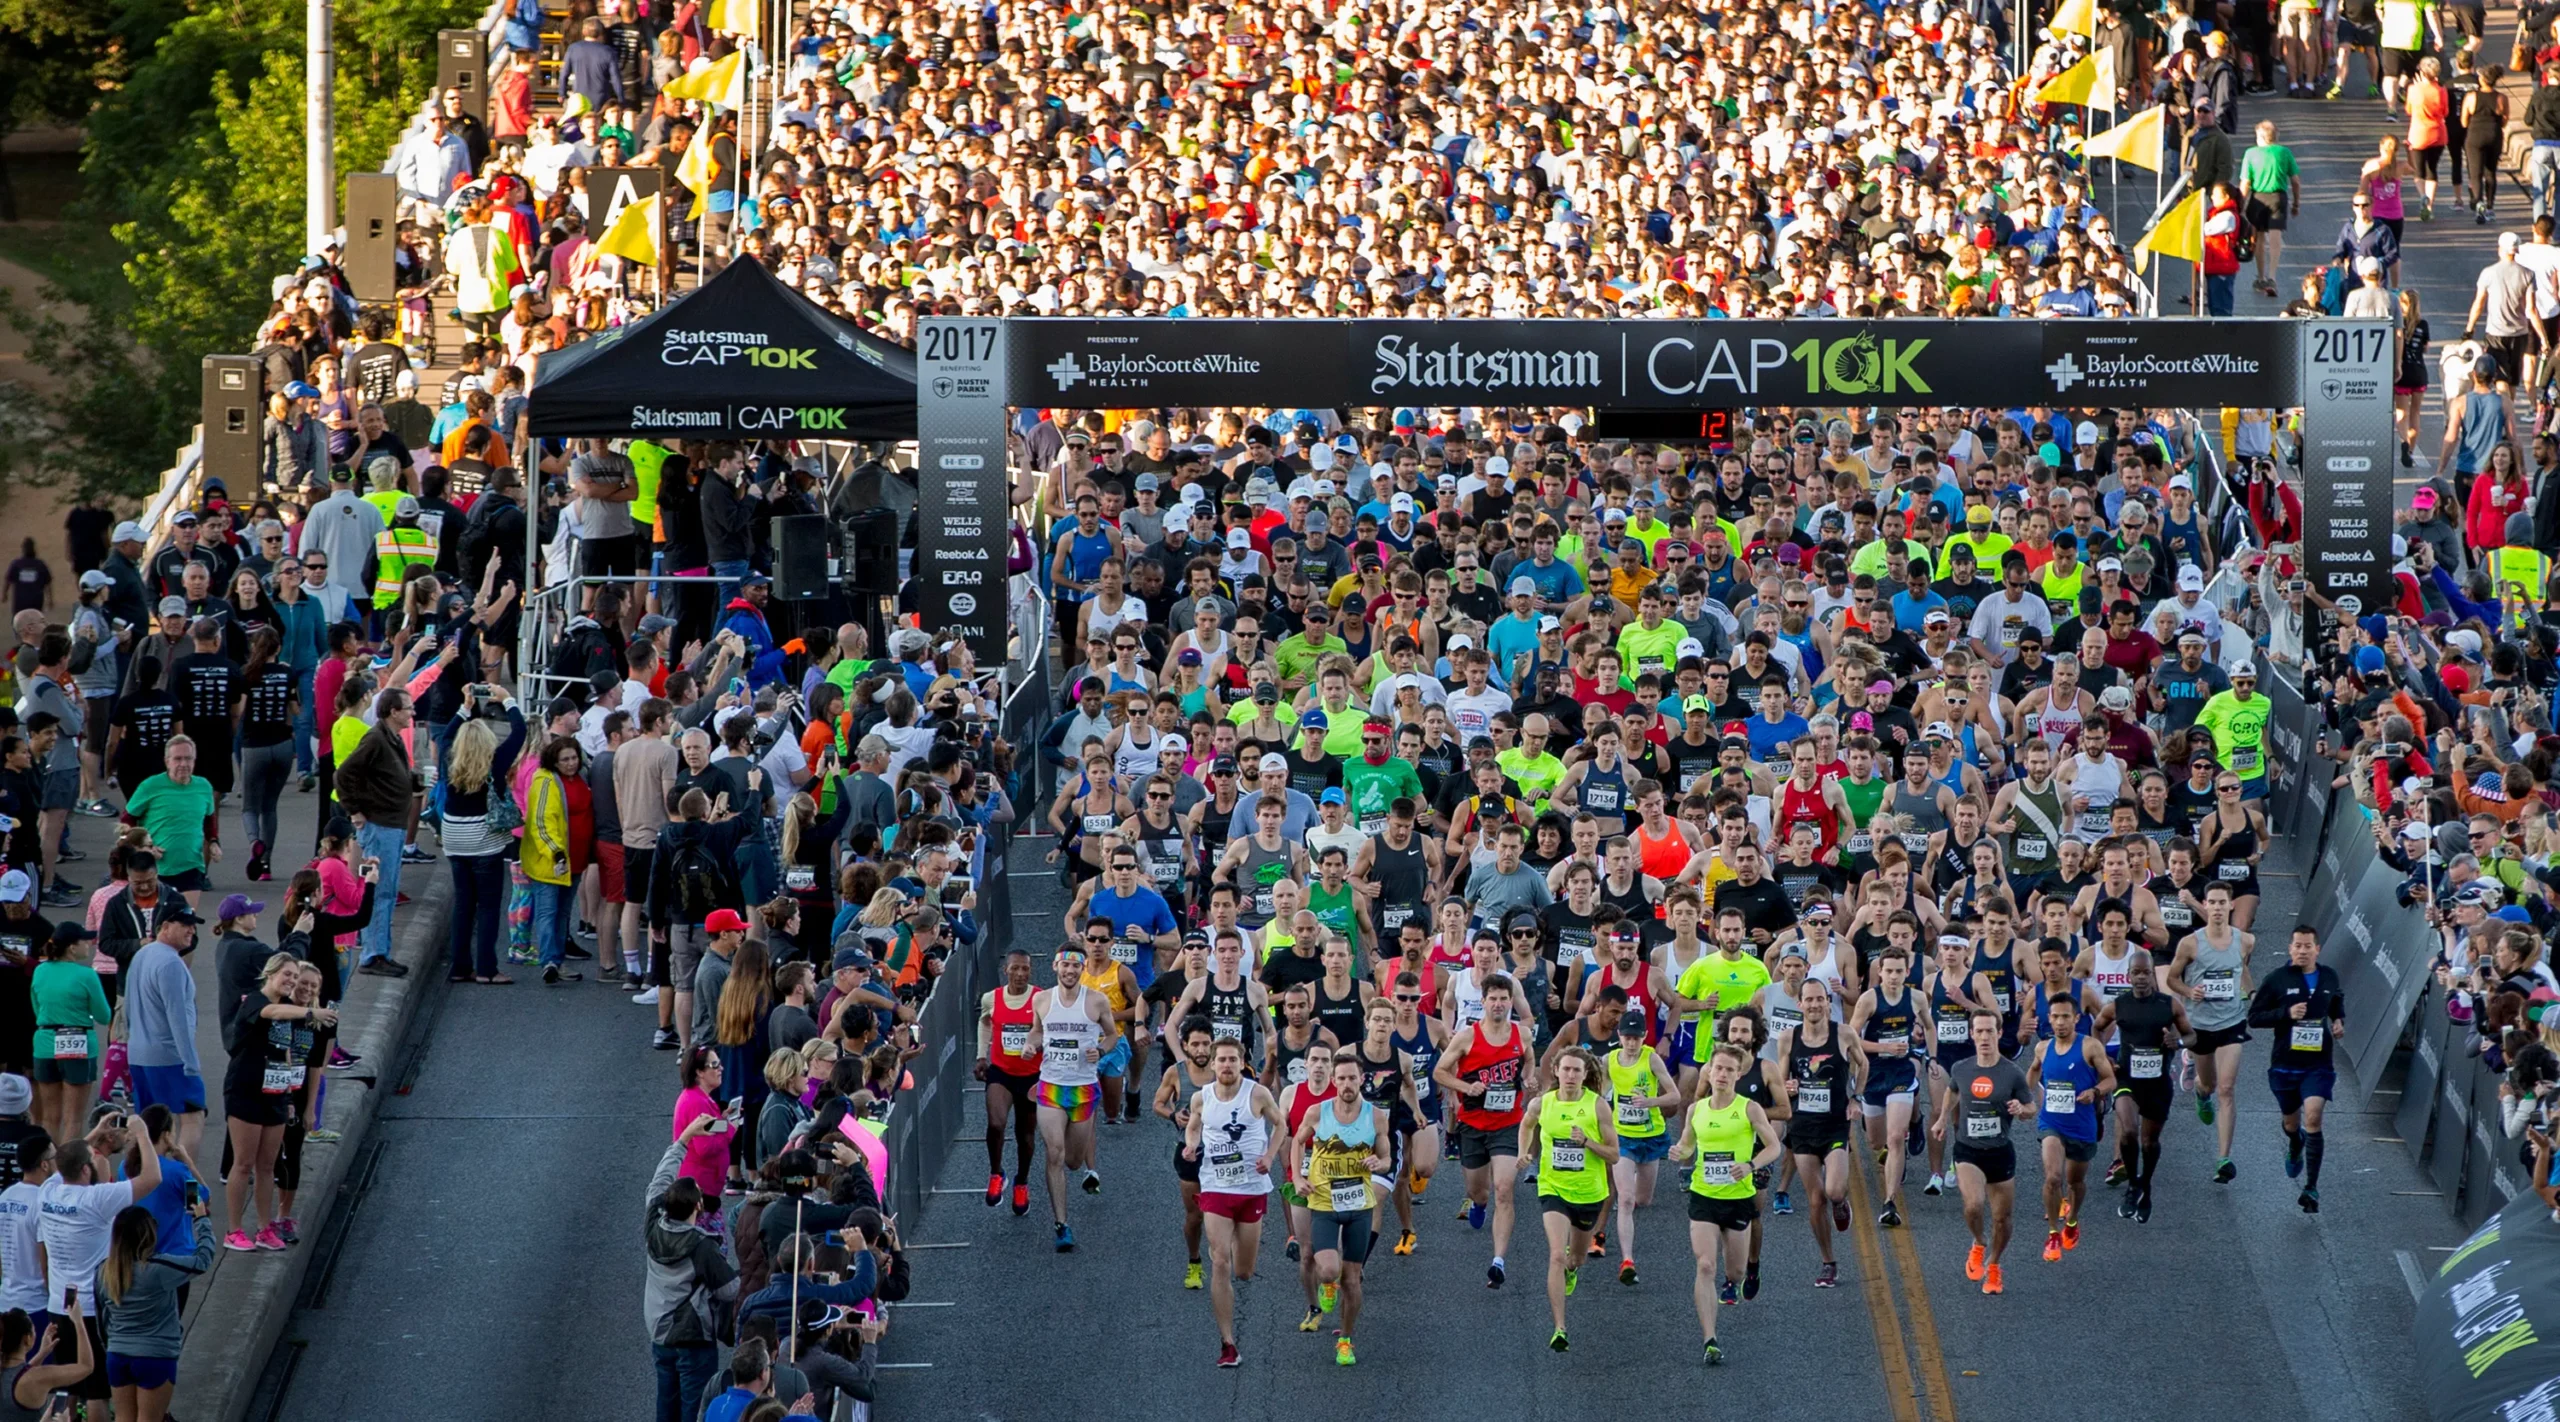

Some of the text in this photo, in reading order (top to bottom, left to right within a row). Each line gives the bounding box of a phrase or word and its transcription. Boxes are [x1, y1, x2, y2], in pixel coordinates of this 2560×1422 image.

[663, 329, 768, 347] Statesman
[924, 326, 997, 361] 2017
[2313, 328, 2386, 363] 2017
[661, 346, 818, 370] CAP10K
[1371, 332, 1933, 394] Statesman CAP10K
[1088, 353, 1260, 377] BaylorScott&White
[2087, 354, 2259, 377] BaylorScott&White
[1089, 378, 1149, 387] HEALTH
[2088, 379, 2147, 388] HEALTH
[631, 405, 847, 430] Statesman CAP10K
[1701, 413, 1726, 438] 12
[943, 517, 982, 526] WELLS
[2329, 519, 2368, 528] WELLS
[944, 527, 981, 536] FARGO
[2331, 529, 2368, 538] FARGO
[935, 549, 975, 560] Reebok
[2321, 552, 2361, 562] Reebok
[940, 626, 984, 636] DANI
[2170, 682, 2203, 698] GRI
[1590, 793, 1615, 802] 17136
[1086, 819, 1110, 827] 15581
[1368, 822, 1381, 831] 311
[2020, 843, 2044, 852] 4247
[1946, 848, 1966, 872] TEAM
[1154, 868, 1177, 876] 6833
[2164, 912, 2189, 920] 6238
[1112, 948, 1136, 956] 2359
[2204, 984, 2232, 992] 13459
[1212, 994, 1244, 1004] RAW
[1069, 1024, 1088, 1033] ROCK
[1214, 1027, 1240, 1038] 9992
[1940, 1026, 1966, 1034] 3590
[1003, 1036, 1026, 1046] 1508
[2296, 1032, 2320, 1040] 7479
[56, 1040, 86, 1048] 15397
[1048, 1050, 1078, 1061] 17328
[2132, 1059, 2162, 1068] 19209
[1478, 1058, 1520, 1085] BEEF
[266, 1074, 291, 1084] 13545
[1490, 1094, 1512, 1104] 1733
[1800, 1092, 1829, 1102] 18748
[1622, 1108, 1644, 1117] 7419
[1971, 1122, 1997, 1131] 7254
[1552, 1152, 1584, 1162] 15260
[1214, 1165, 1246, 1178] 19982
[1705, 1166, 1729, 1176] 2183
[1332, 1190, 1364, 1203] 19668
